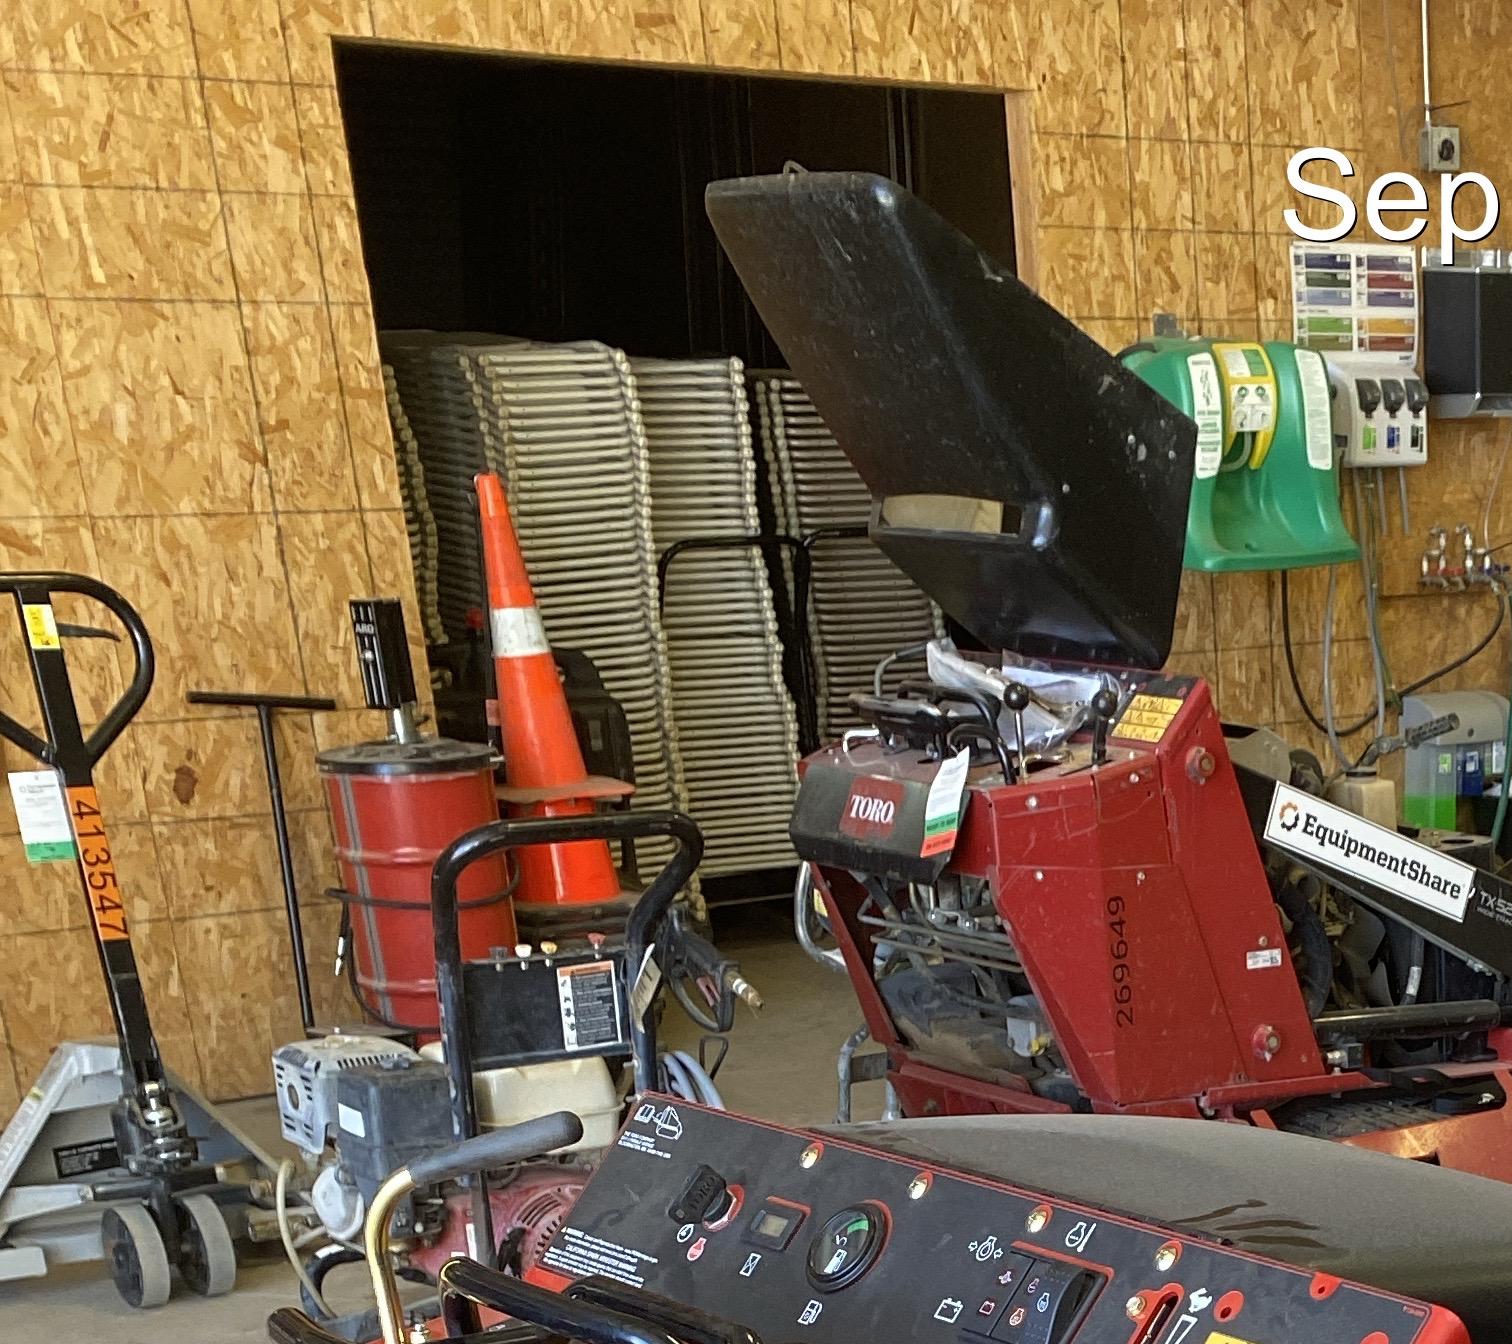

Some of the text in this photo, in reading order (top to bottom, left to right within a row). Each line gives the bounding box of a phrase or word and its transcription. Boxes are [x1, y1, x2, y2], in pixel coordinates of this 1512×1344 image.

[850, 794, 895, 824] TORO
[1301, 812, 1462, 900] EquipmentShare
[72, 799, 129, 938] 413547
[1107, 895, 1134, 1028] 269649
